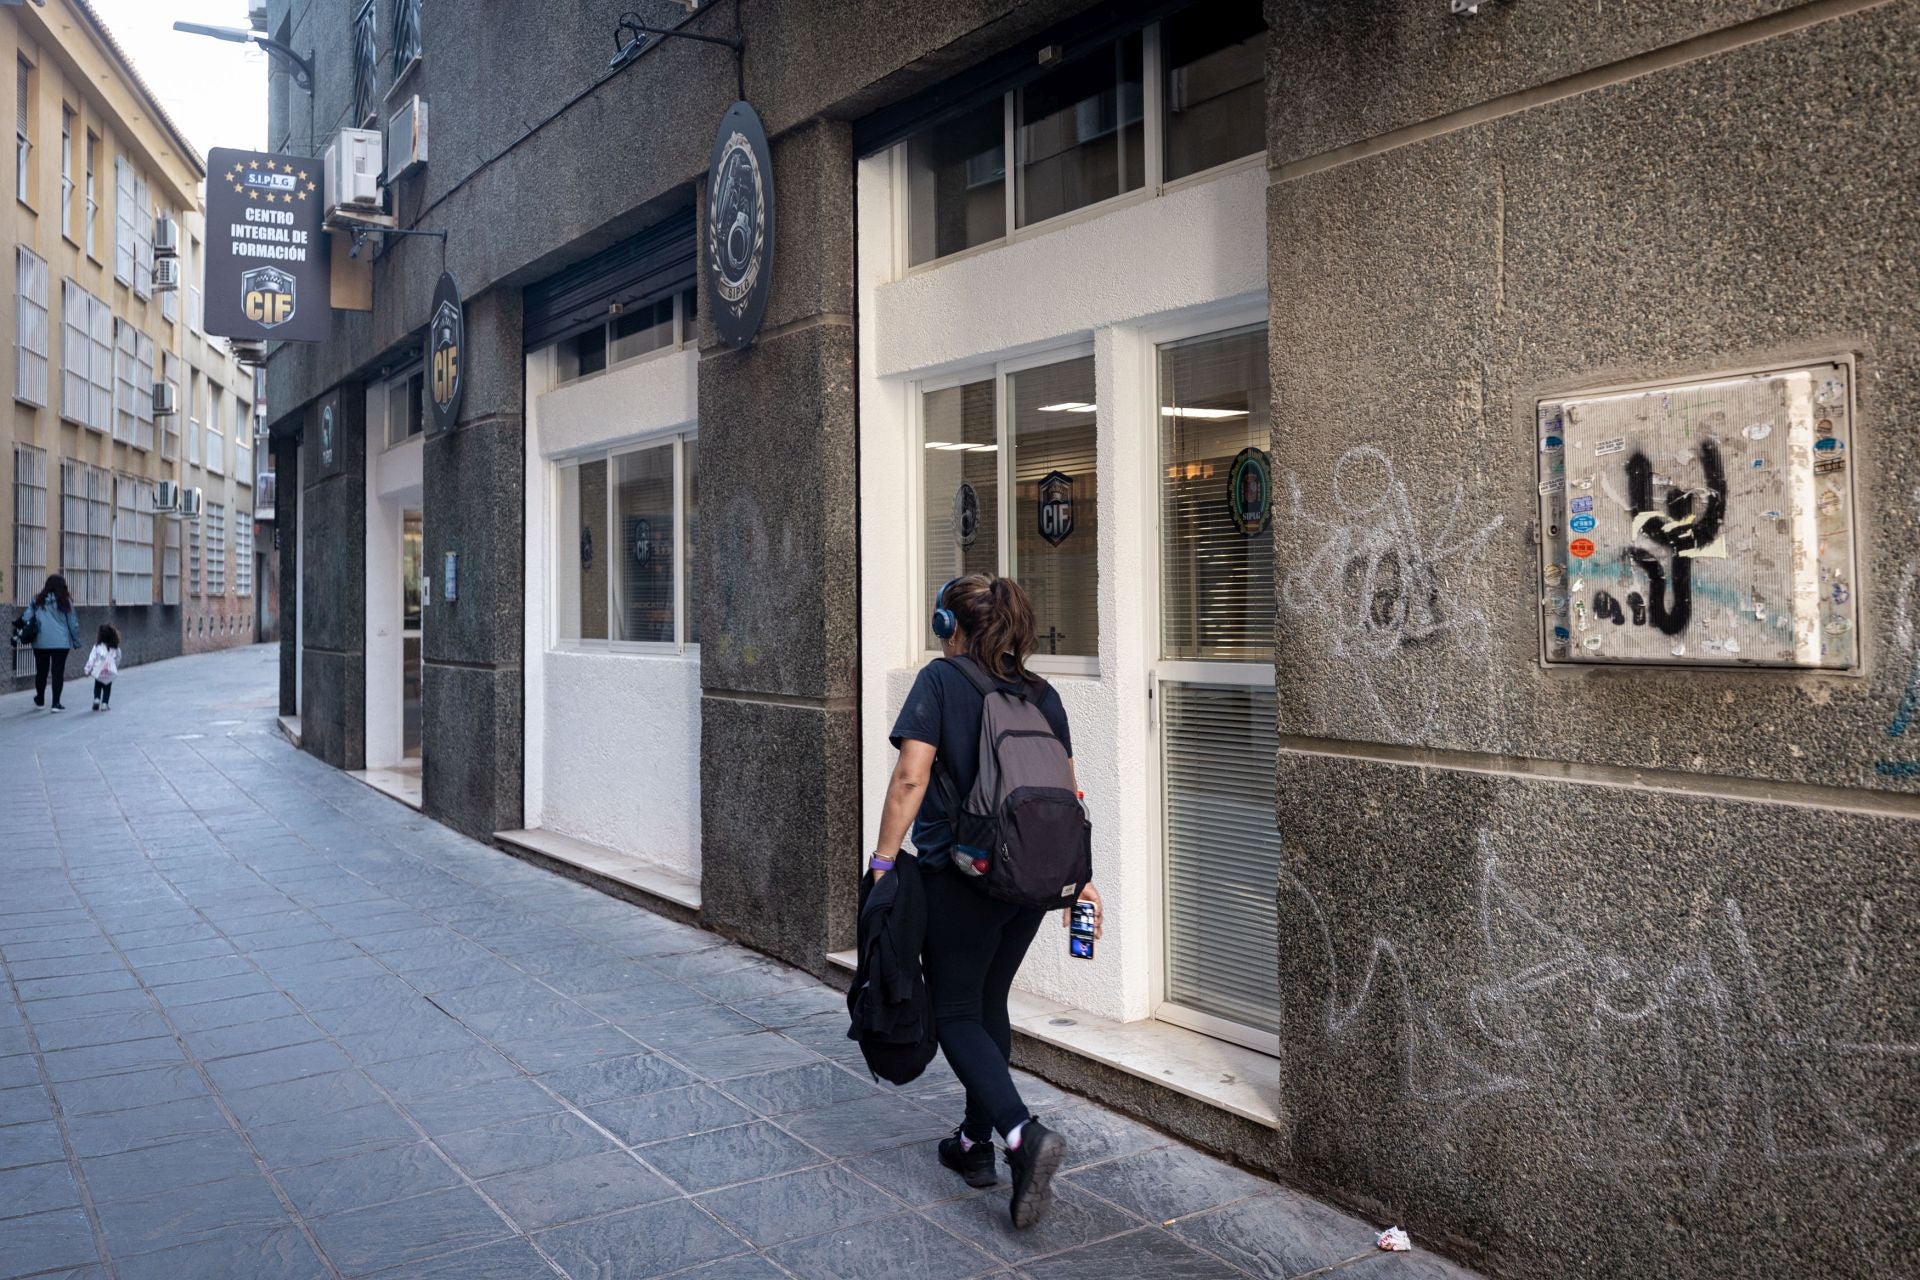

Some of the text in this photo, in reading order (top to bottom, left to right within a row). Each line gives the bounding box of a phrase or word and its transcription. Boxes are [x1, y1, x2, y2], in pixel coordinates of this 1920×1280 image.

[245, 207, 295, 226] CENTRO
[231, 223, 308, 245] INTEGRAL DE
[232, 241, 306, 262] FORMACIÓN
[246, 291, 292, 323] CIF
[434, 347, 457, 403] CIF
[1043, 503, 1069, 536] CIF
